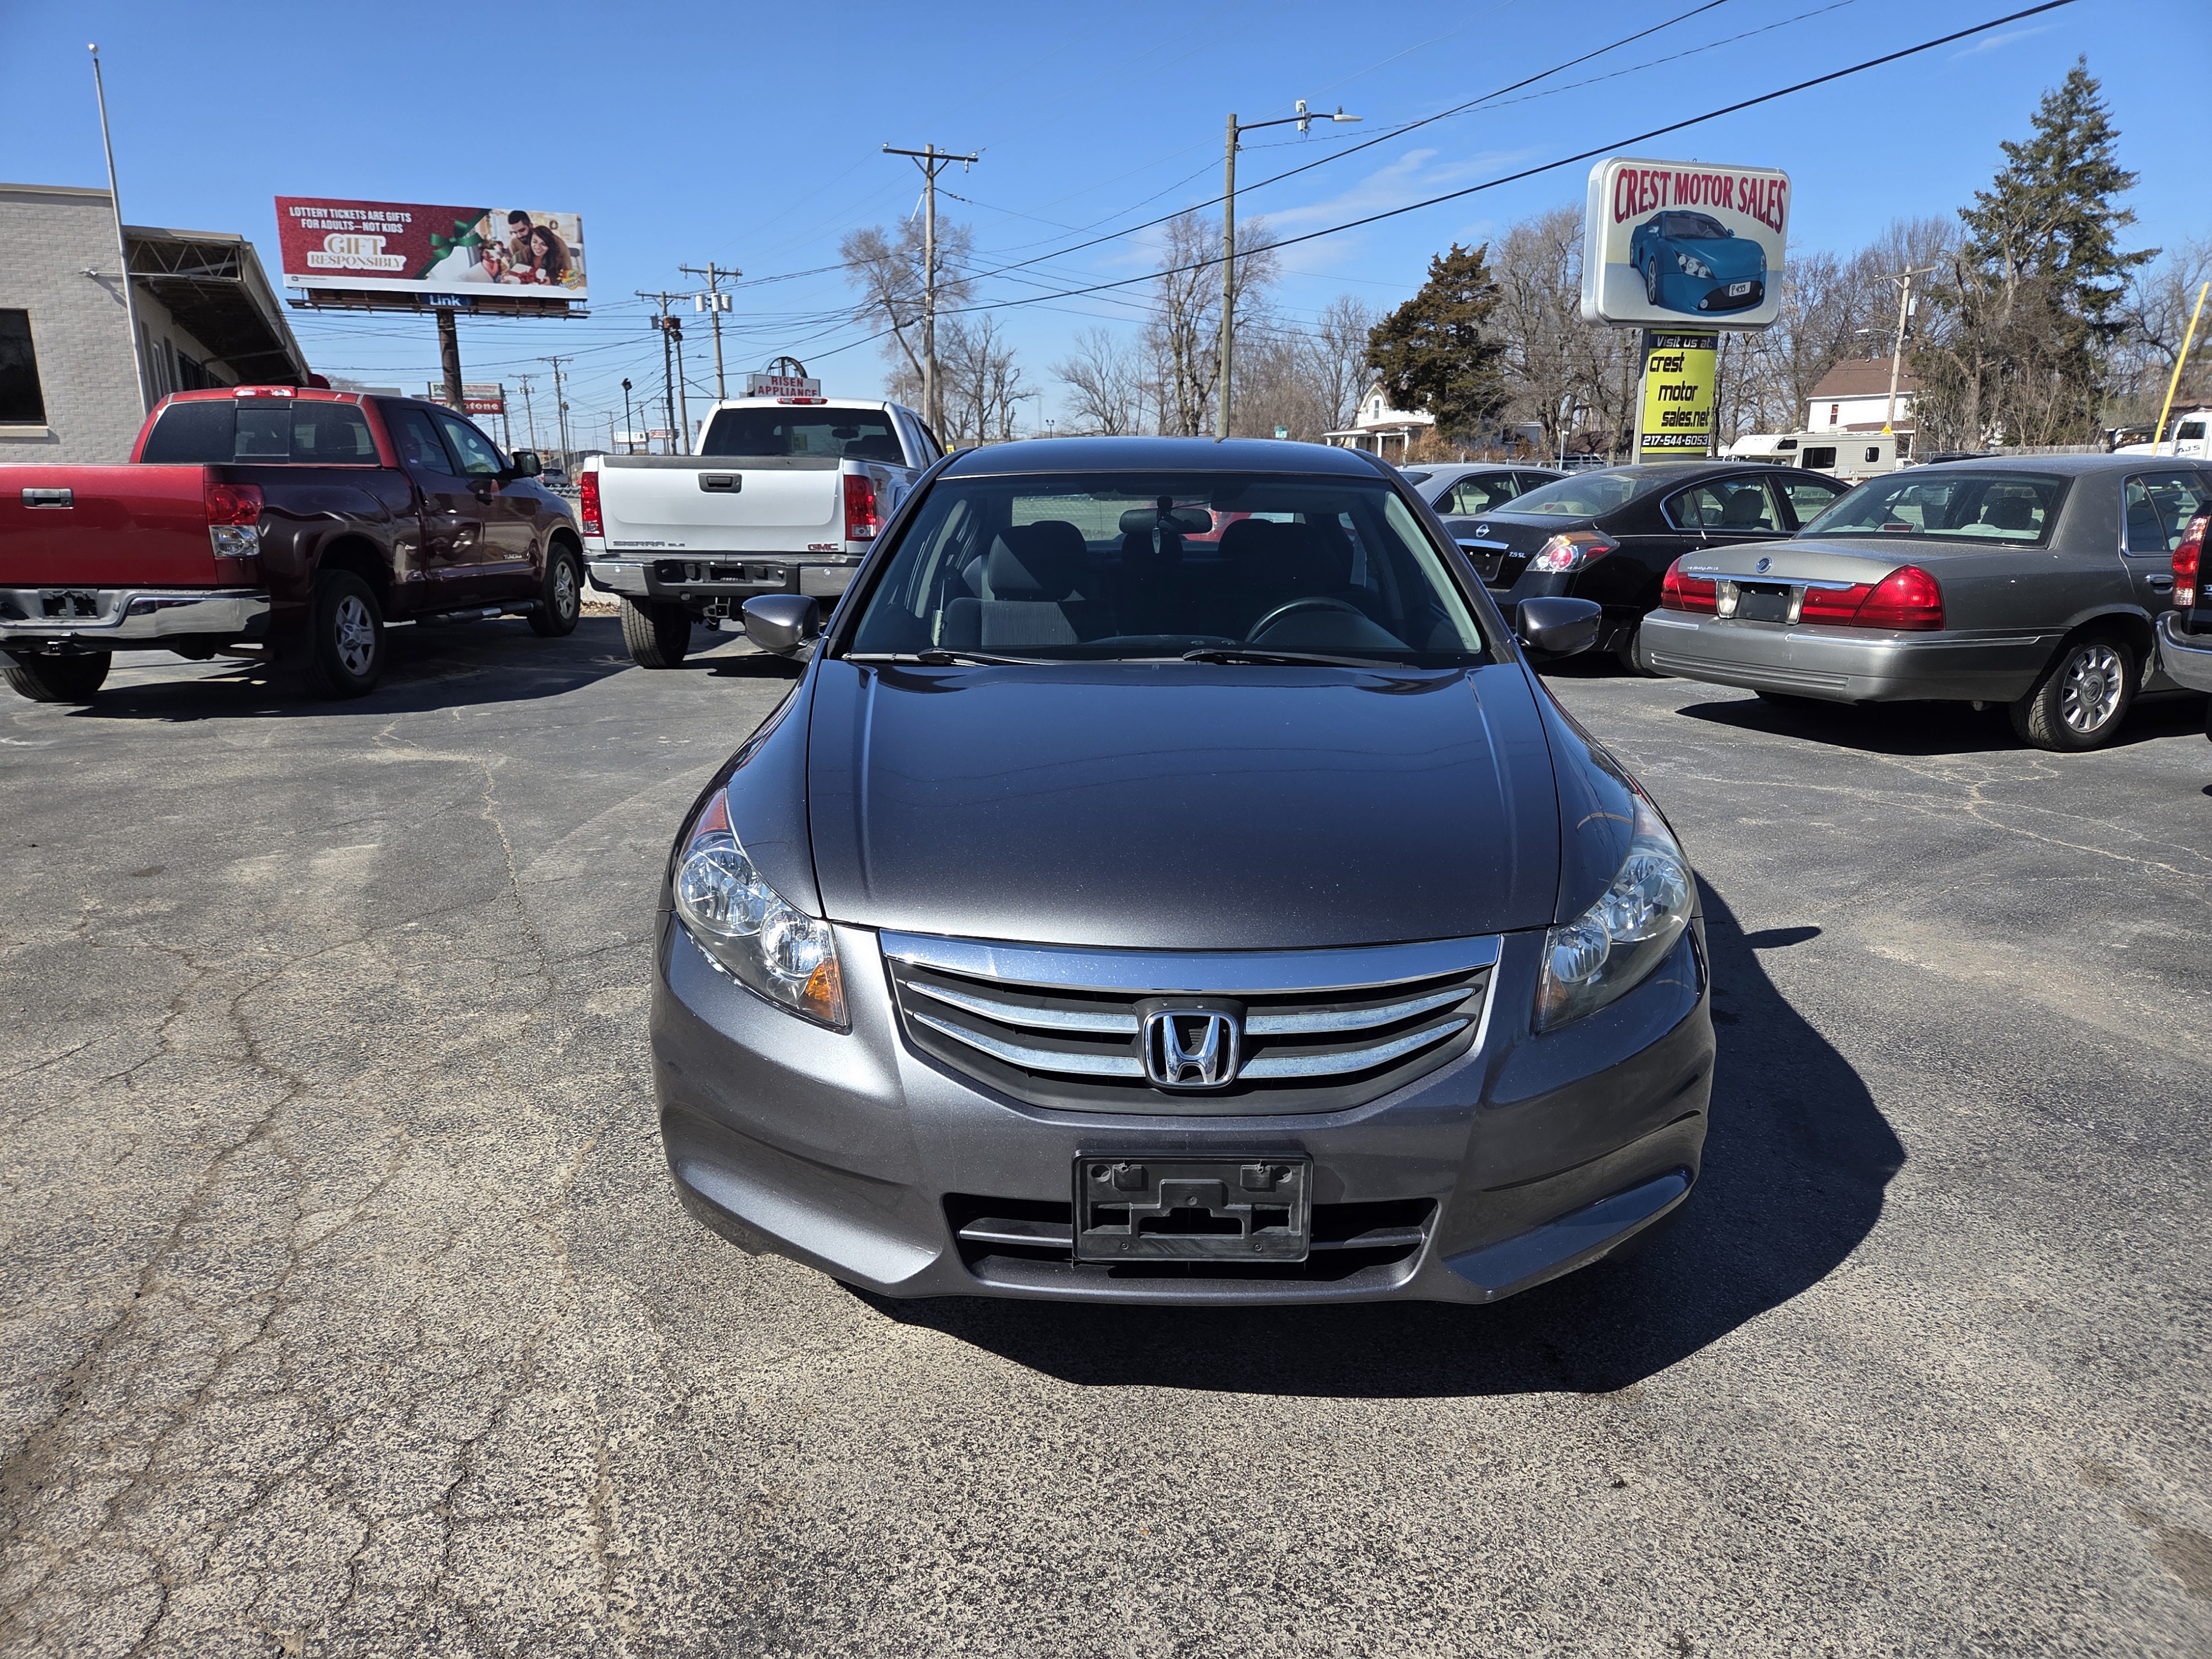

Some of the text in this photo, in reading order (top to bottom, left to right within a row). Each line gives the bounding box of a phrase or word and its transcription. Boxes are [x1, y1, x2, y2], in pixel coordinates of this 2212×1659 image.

[1614, 168, 1787, 234] CREST MOTOR SALES
[289, 207, 412, 223] LOTTERY TICKETS ARE GIFTS
[301, 218, 320, 229] FOR
[382, 223, 404, 233] KIDS
[327, 236, 383, 255] GIFT
[310, 254, 401, 268] RESPONSIBLY
[429, 294, 462, 306] Link
[1657, 336, 1680, 348] Visit
[1683, 339, 1698, 348] us
[1649, 352, 1684, 373] crest
[771, 376, 804, 388] RISEN
[758, 385, 817, 397] APPLIANCE
[1658, 380, 1698, 401] motor
[1661, 406, 1710, 427] sales.net
[807, 543, 839, 551] GMC
